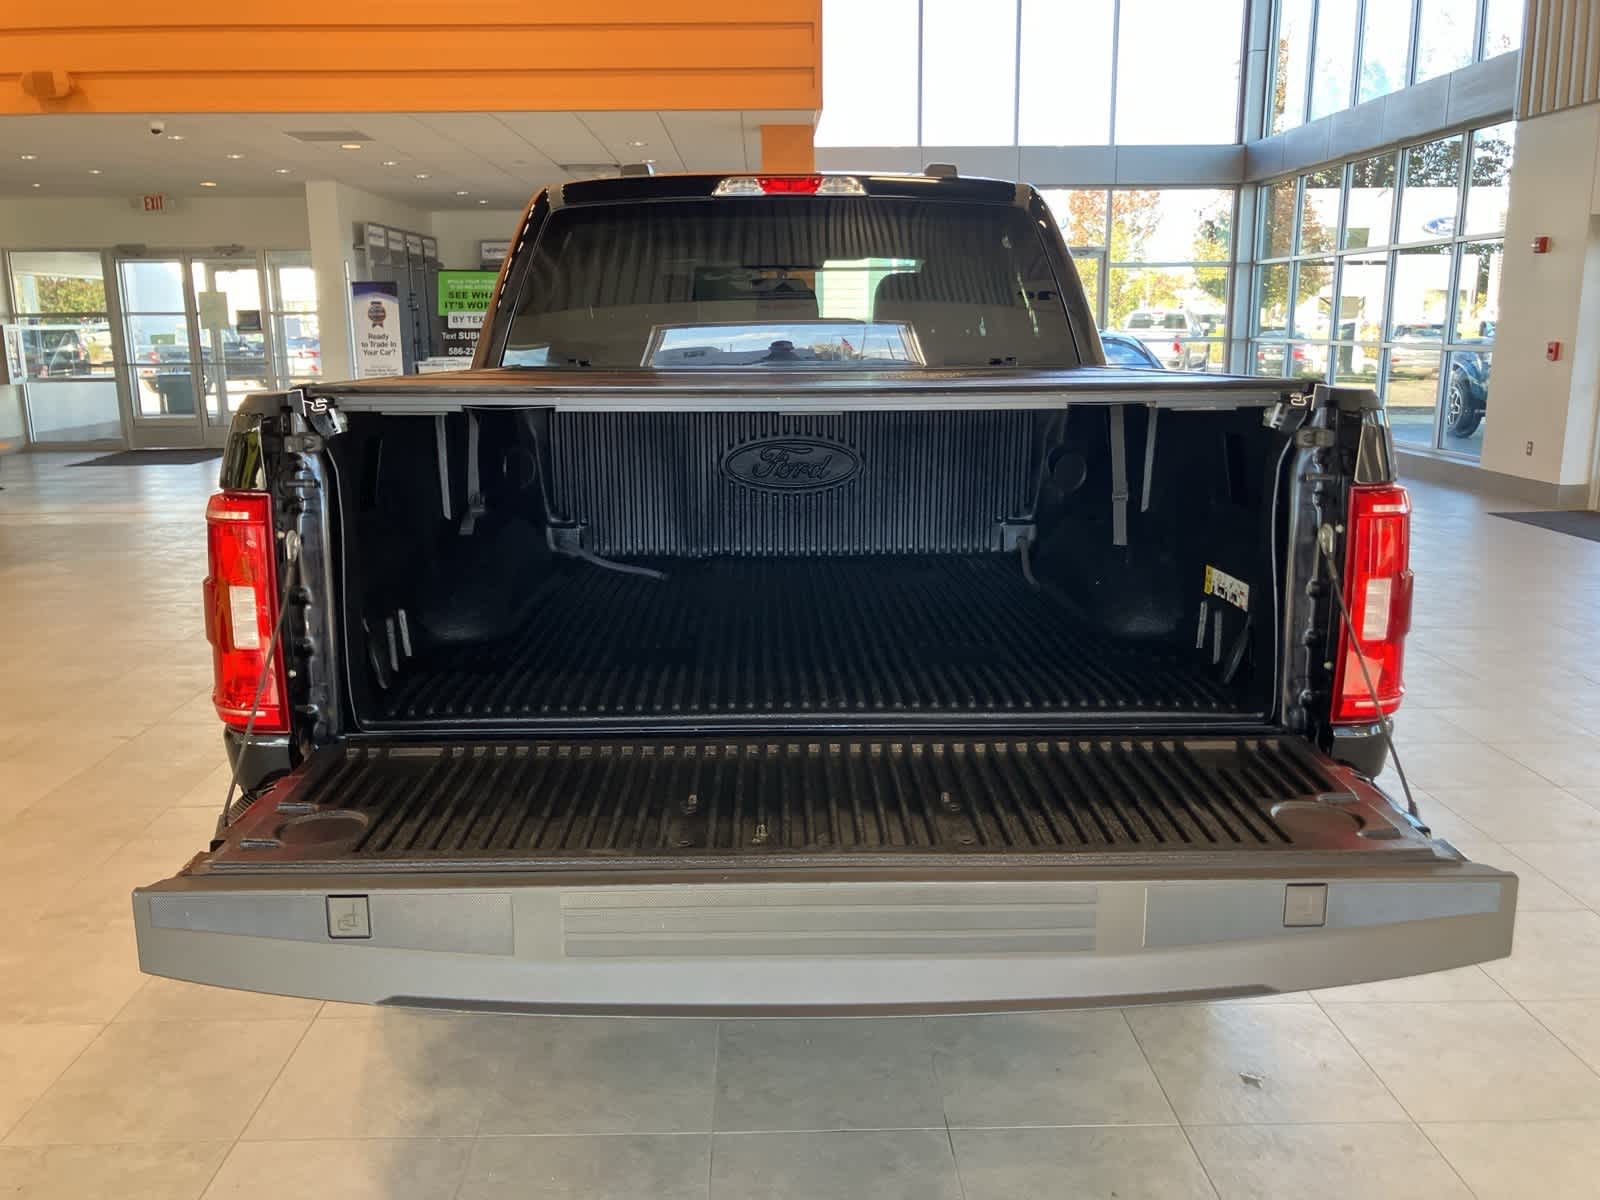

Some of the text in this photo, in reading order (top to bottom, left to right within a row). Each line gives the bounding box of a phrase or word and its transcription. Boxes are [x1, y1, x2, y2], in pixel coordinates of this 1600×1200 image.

[144, 194, 165, 210] EXIT
[368, 333, 390, 342] Ready
[364, 349, 378, 357] Your
[752, 446, 832, 479] Ford
